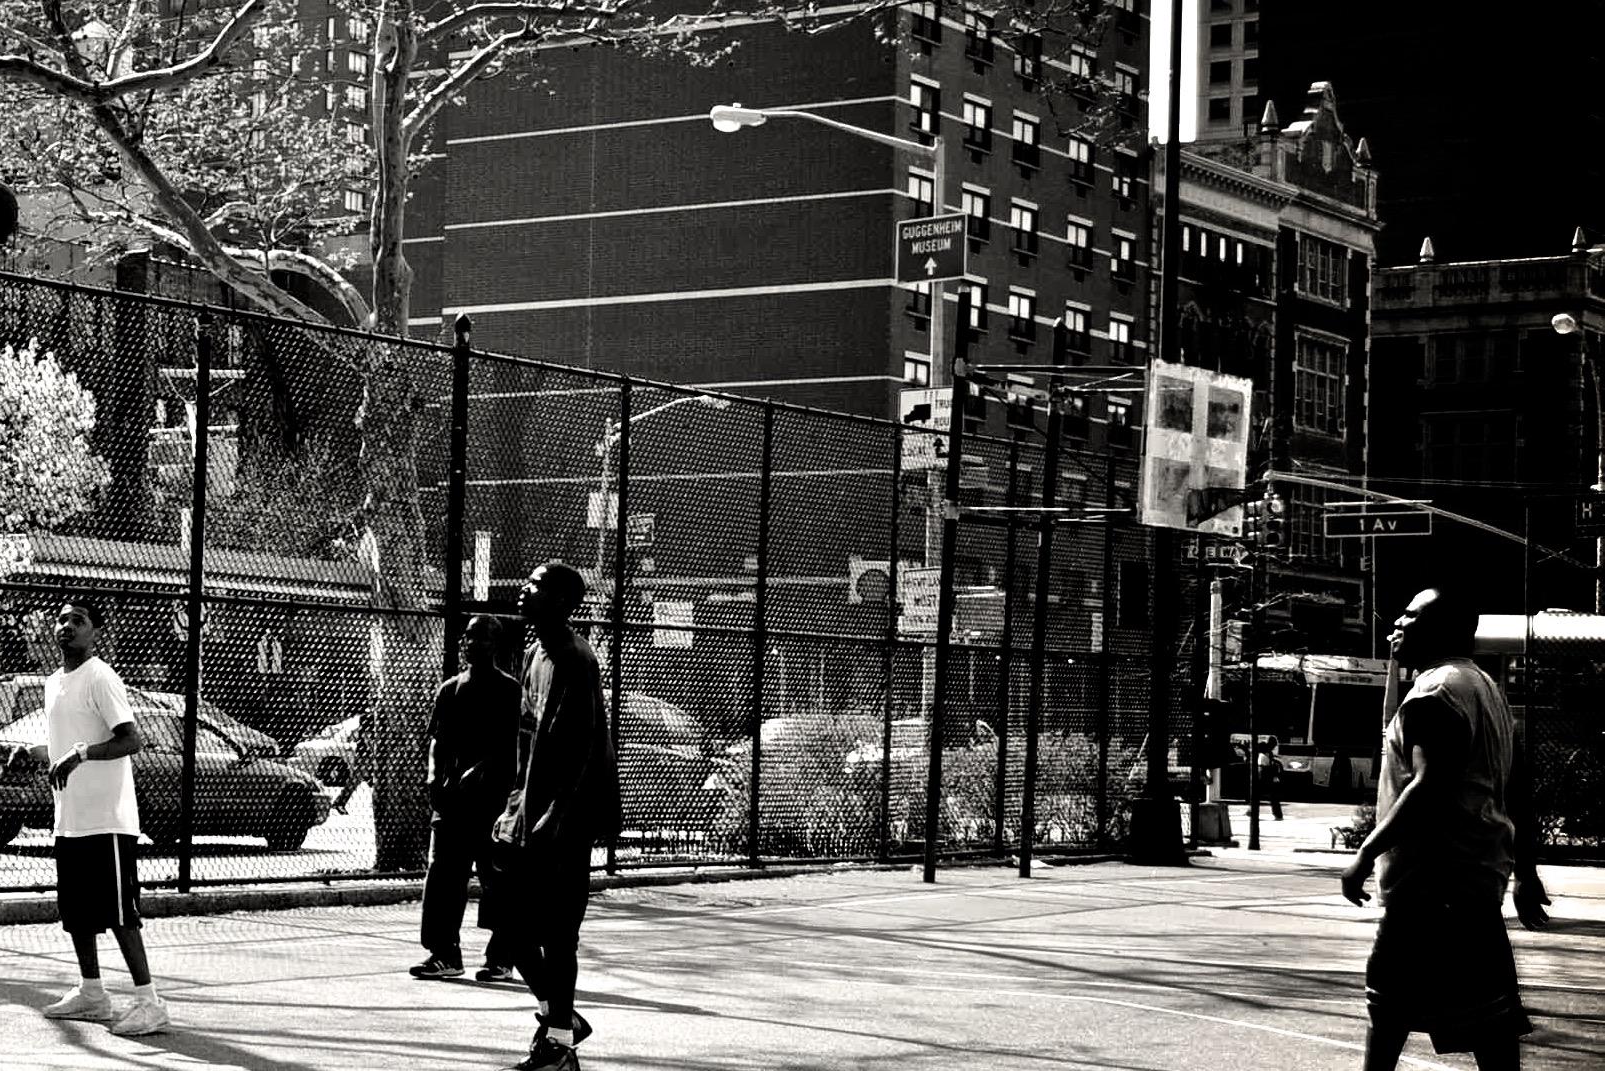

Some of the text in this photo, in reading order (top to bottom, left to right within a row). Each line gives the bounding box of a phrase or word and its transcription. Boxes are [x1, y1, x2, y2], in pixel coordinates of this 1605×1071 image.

[902, 220, 962, 239] GUGGENHEIM
[912, 239, 951, 254] MUSEUM
[1360, 518, 1397, 531] 1 Av
